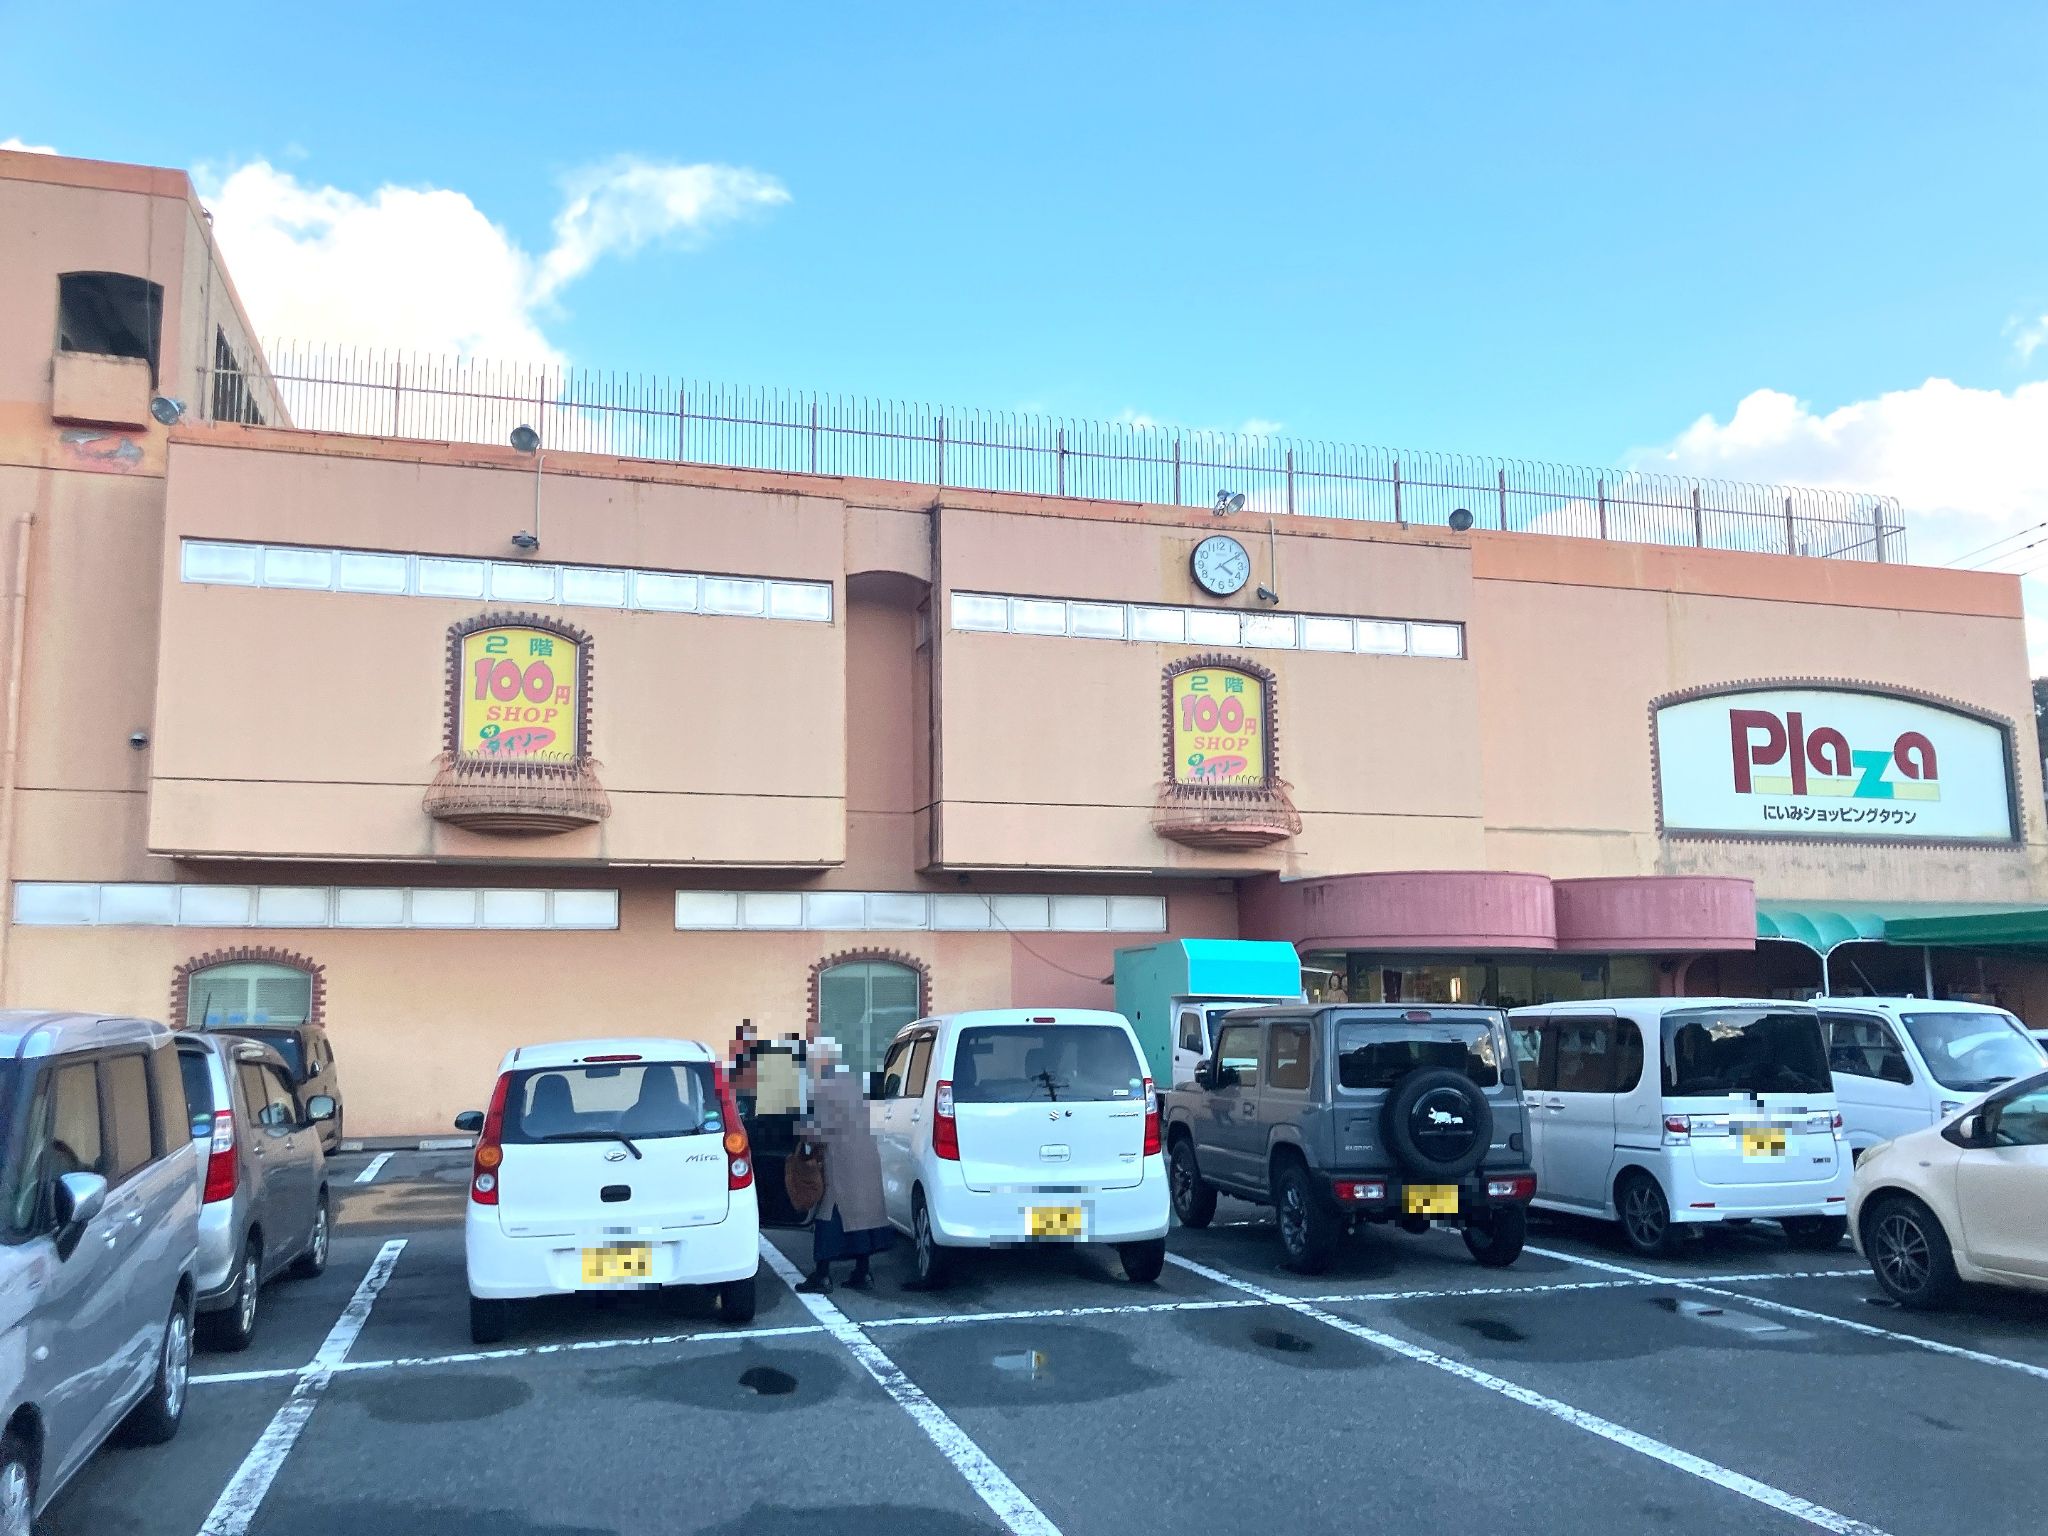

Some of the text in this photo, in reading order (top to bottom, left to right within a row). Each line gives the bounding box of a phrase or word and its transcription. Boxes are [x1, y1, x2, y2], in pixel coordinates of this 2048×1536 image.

[1208, 543, 1215, 552] 11
[1216, 542, 1225, 550] 12
[1199, 551, 1208, 559] 10
[1198, 560, 1204, 569] 9
[1237, 562, 1243, 570] 3
[1202, 570, 1208, 578] 8
[1235, 572, 1241, 580] 4
[1210, 578, 1215, 586] 7
[1218, 581, 1224, 589] 6
[1228, 579, 1234, 587] 5
[486, 705, 559, 723] SHOP
[1194, 736, 1249, 751] SHOP
[1763, 804, 1917, 824] にいみショッピングタウン
[685, 1153, 720, 1163] Mira
